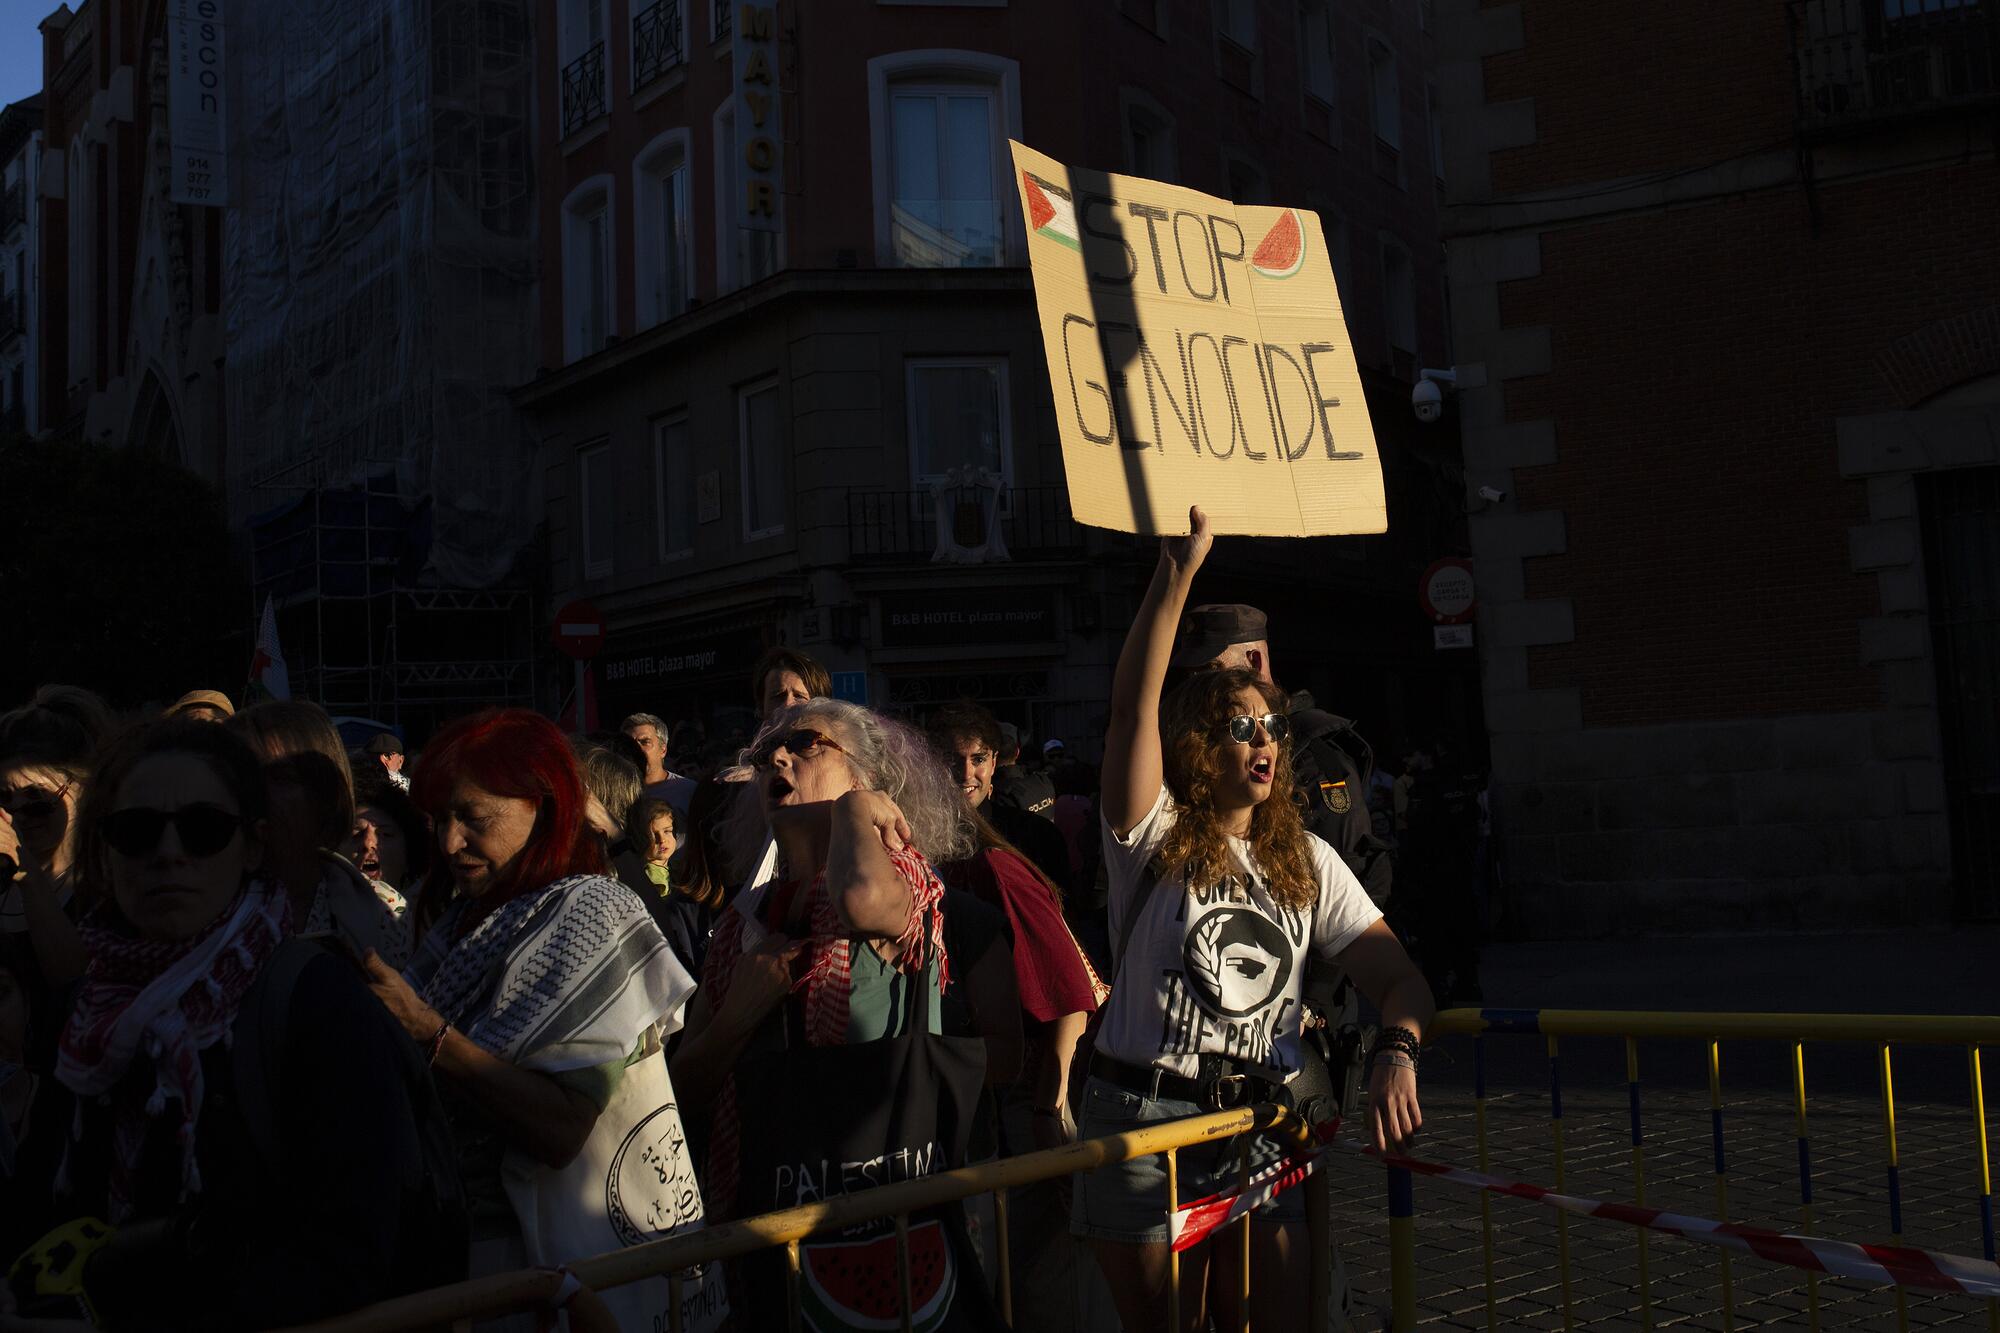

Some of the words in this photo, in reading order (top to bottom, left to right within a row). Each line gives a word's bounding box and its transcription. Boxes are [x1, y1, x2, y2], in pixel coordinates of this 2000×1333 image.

[741, 4, 775, 218] MAYOR
[187, 157, 209, 169] 914
[1080, 195, 1245, 306] STOP
[1062, 312, 1364, 464] GENOCIDE
[892, 612, 921, 625] B&B
[924, 611, 965, 624] HOTEL
[969, 611, 1002, 625] plaza
[1005, 610, 1044, 625] mayor
[606, 662, 626, 680] B&B
[626, 656, 657, 678] HOTEL
[658, 656, 684, 677] plaza
[685, 650, 717, 671] mayor
[842, 675, 856, 693] H
[1158, 969, 1217, 1054] THE
[774, 1141, 949, 1210] PALESTINA
